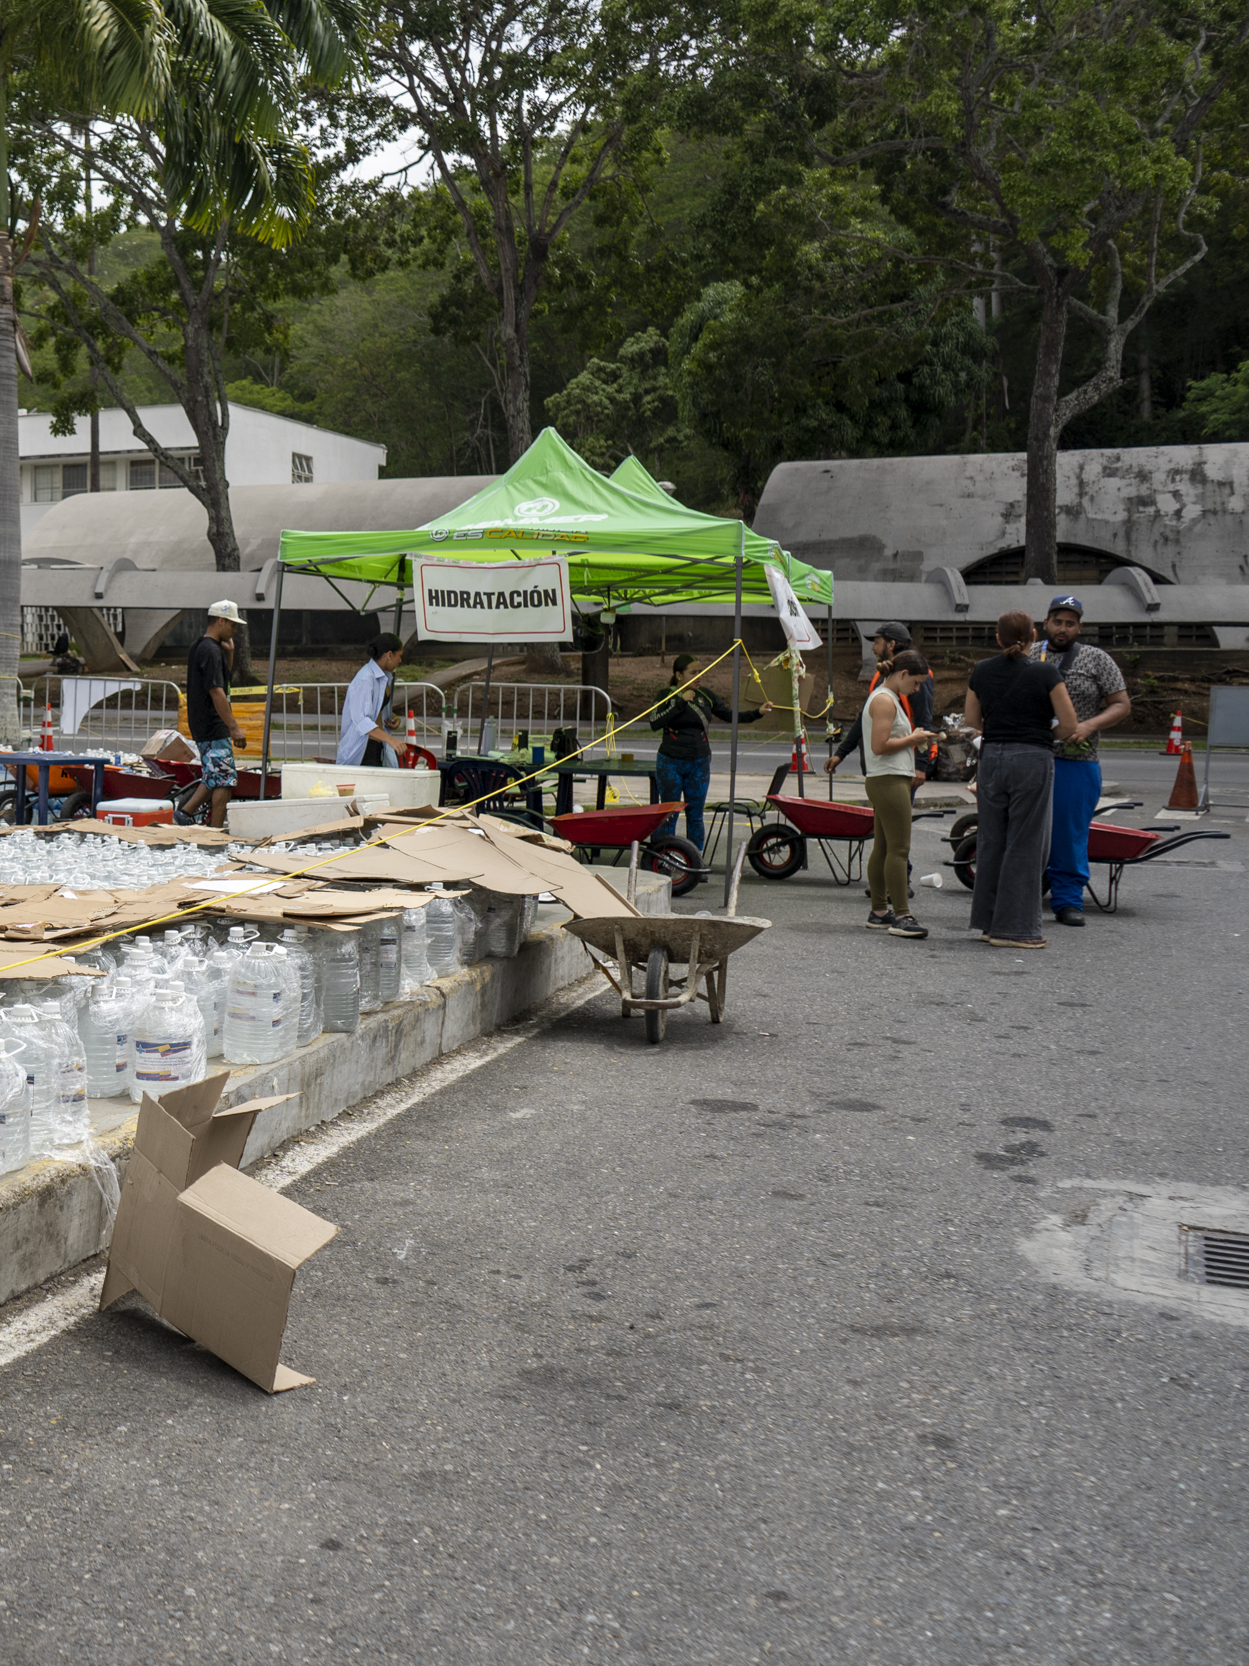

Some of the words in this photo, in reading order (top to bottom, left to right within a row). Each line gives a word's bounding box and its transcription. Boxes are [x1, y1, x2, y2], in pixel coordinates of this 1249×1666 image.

[453, 529, 484, 541] ES
[485, 528, 589, 542] CALIDAD
[427, 584, 558, 610] HIDRATACIÓN
